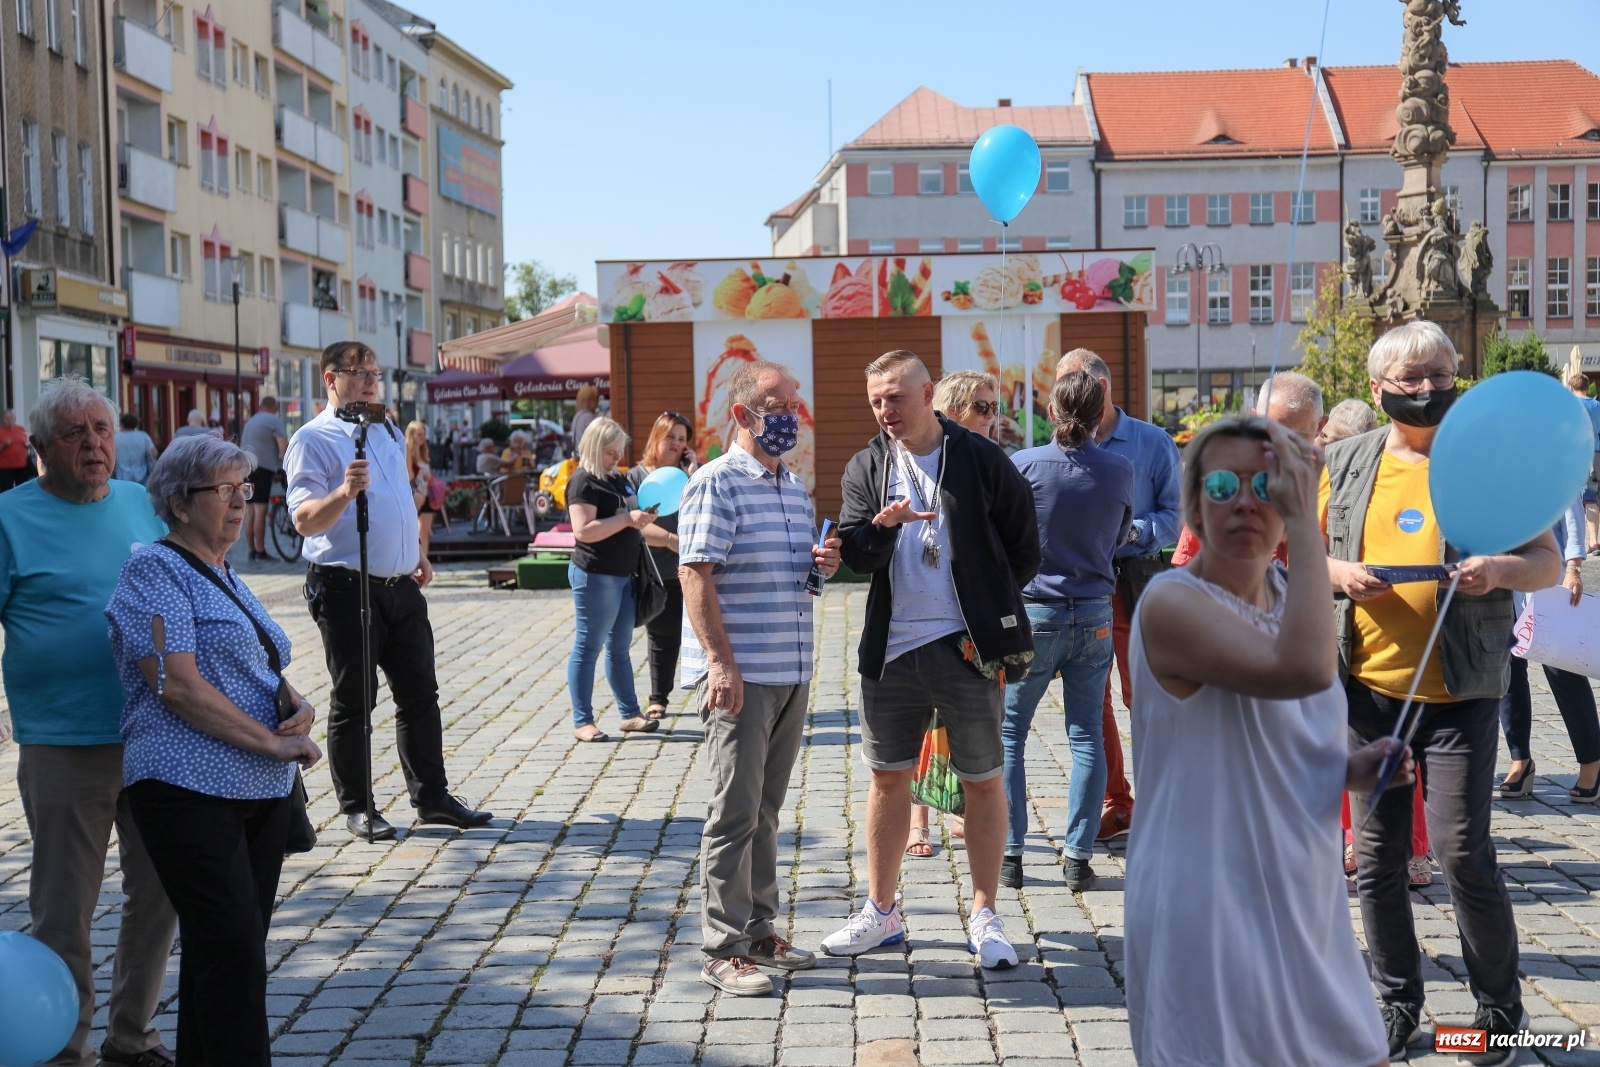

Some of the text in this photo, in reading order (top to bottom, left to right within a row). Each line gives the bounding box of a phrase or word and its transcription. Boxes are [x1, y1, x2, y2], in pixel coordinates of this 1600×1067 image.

[434, 383, 499, 401] Gelateria Ciao Italia
[514, 381, 563, 395] Gelateria
[565, 378, 589, 390] Ciao
